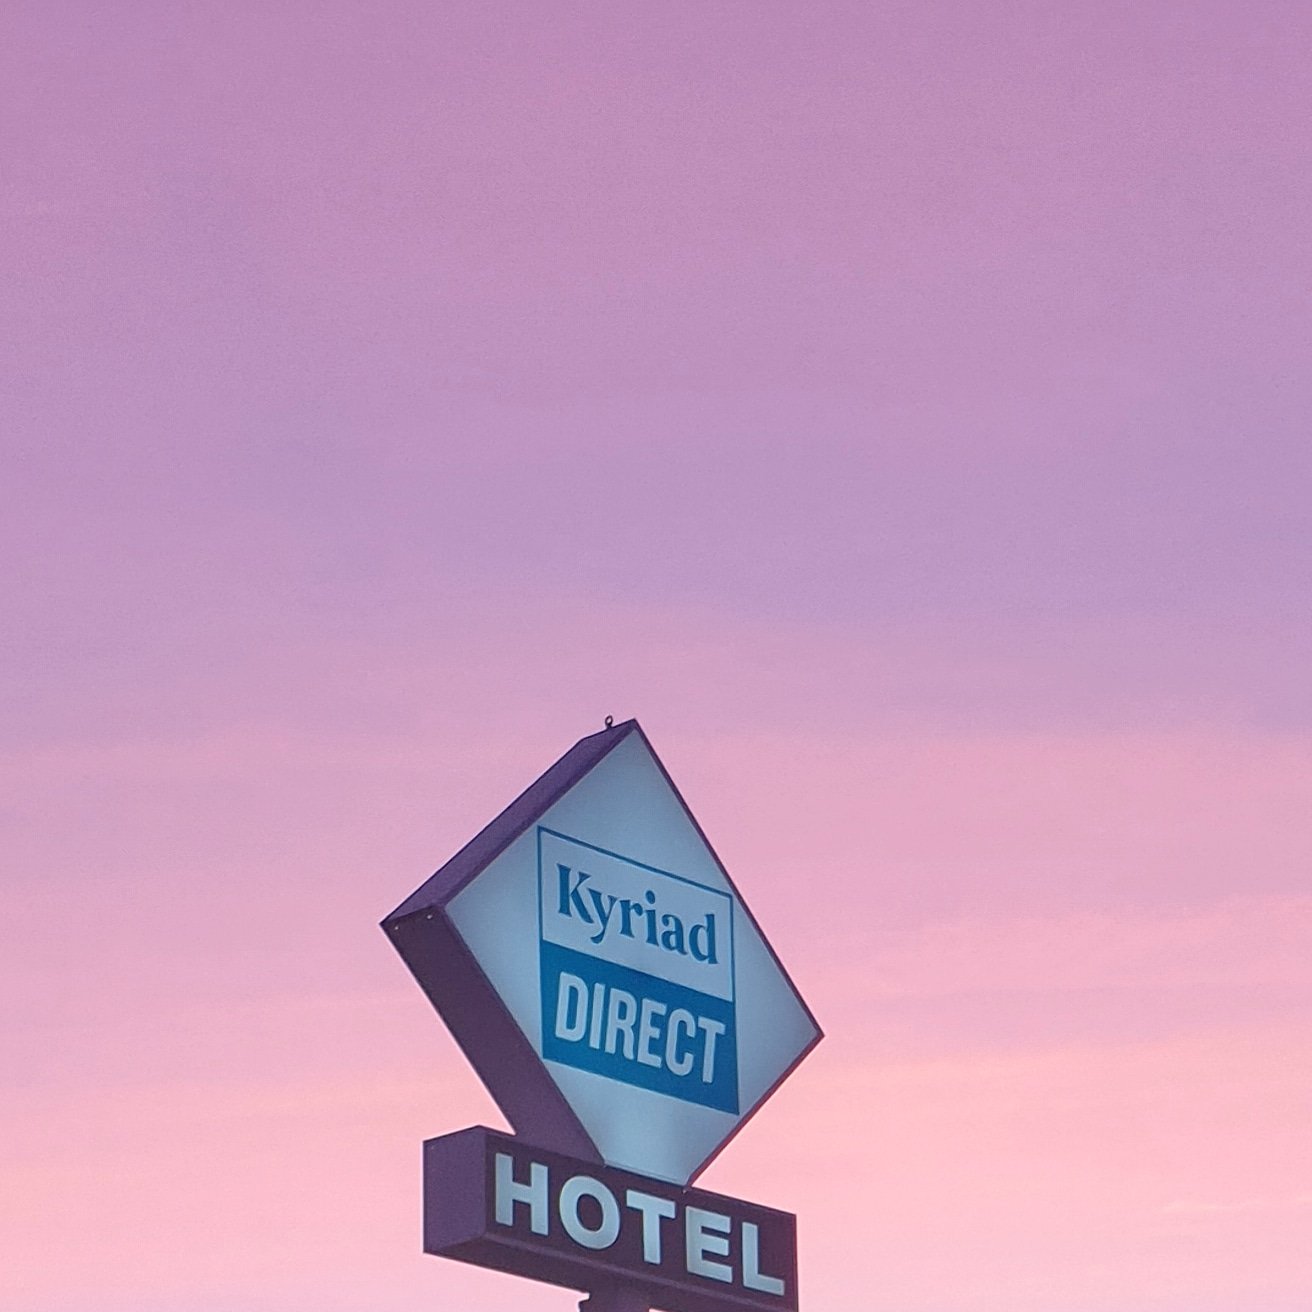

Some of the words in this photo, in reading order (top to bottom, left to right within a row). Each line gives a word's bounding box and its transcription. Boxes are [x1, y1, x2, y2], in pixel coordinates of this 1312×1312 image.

[556, 863, 718, 964] Kyriad
[555, 971, 725, 1083] DIRECT
[495, 1153, 785, 1296] HOTEL
